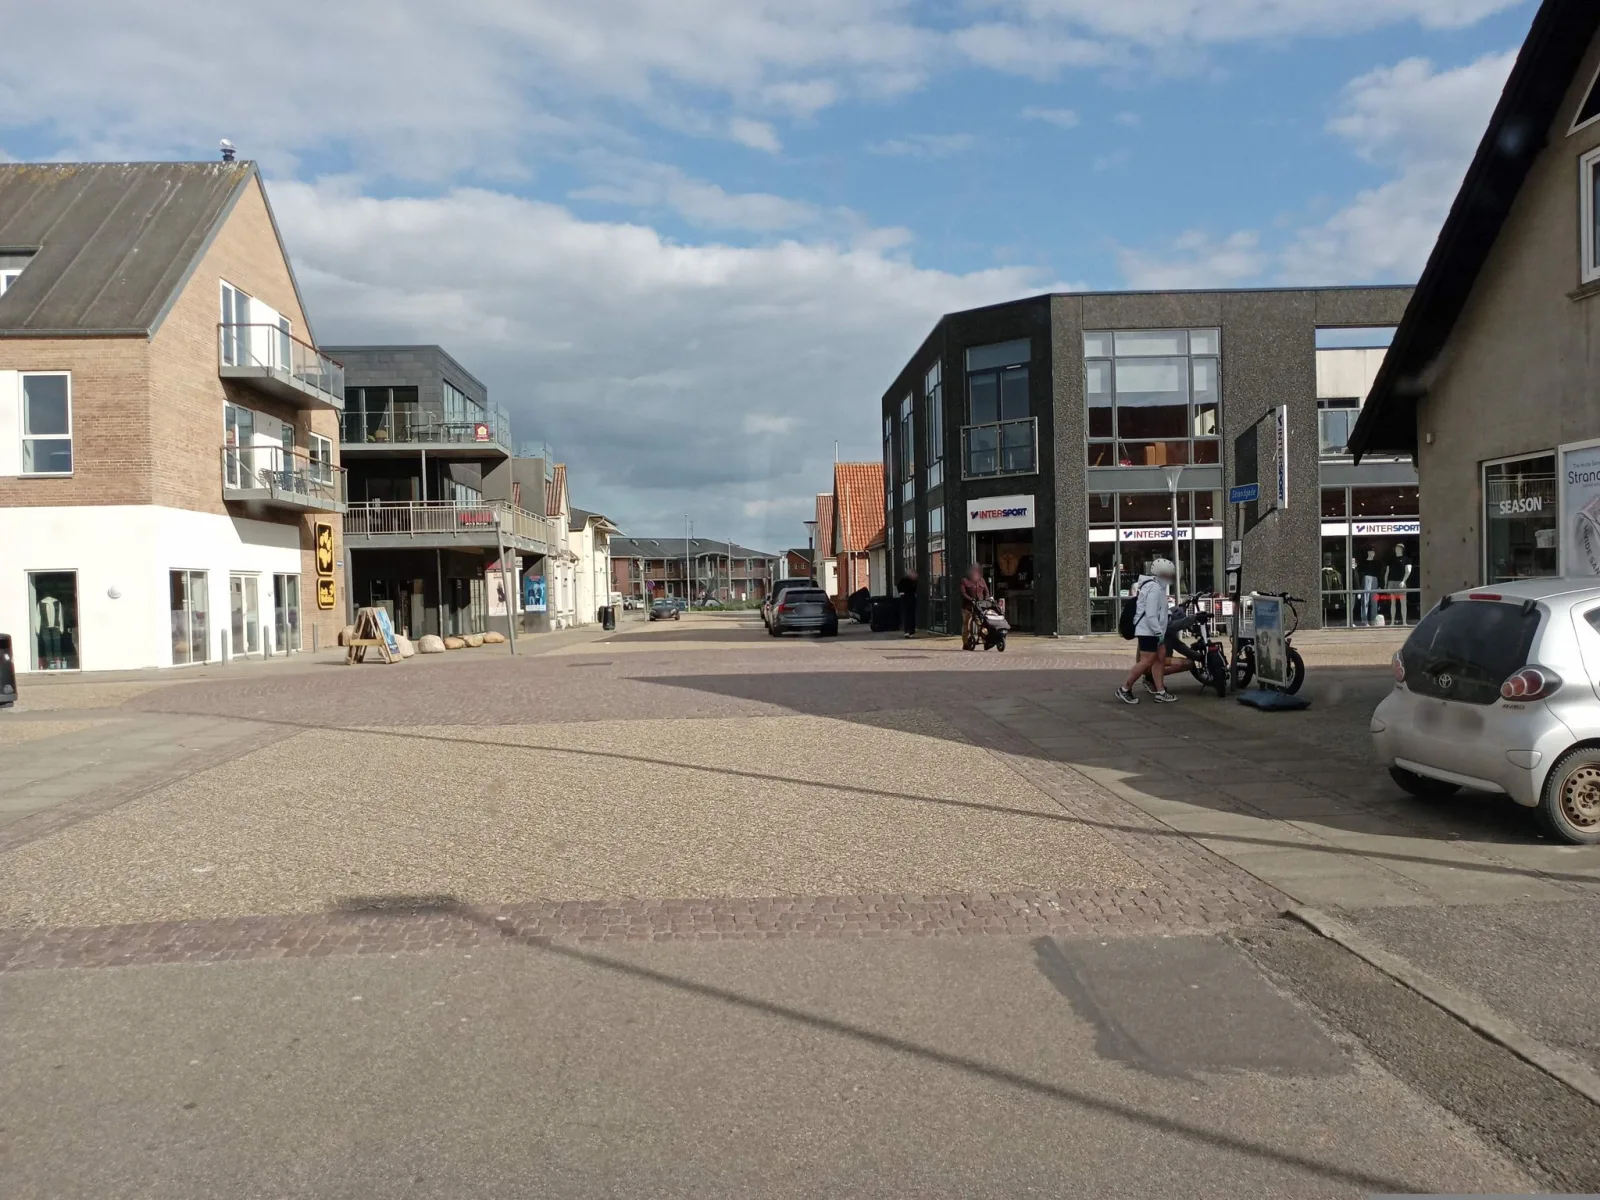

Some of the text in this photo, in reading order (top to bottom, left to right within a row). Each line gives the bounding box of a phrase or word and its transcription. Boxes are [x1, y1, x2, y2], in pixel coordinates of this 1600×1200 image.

[1232, 487, 1256, 499] Strandgade
[1499, 496, 1542, 514] SEASON
[979, 507, 1027, 519] INTERSPORT
[1366, 524, 1420, 532] INTERSPORT
